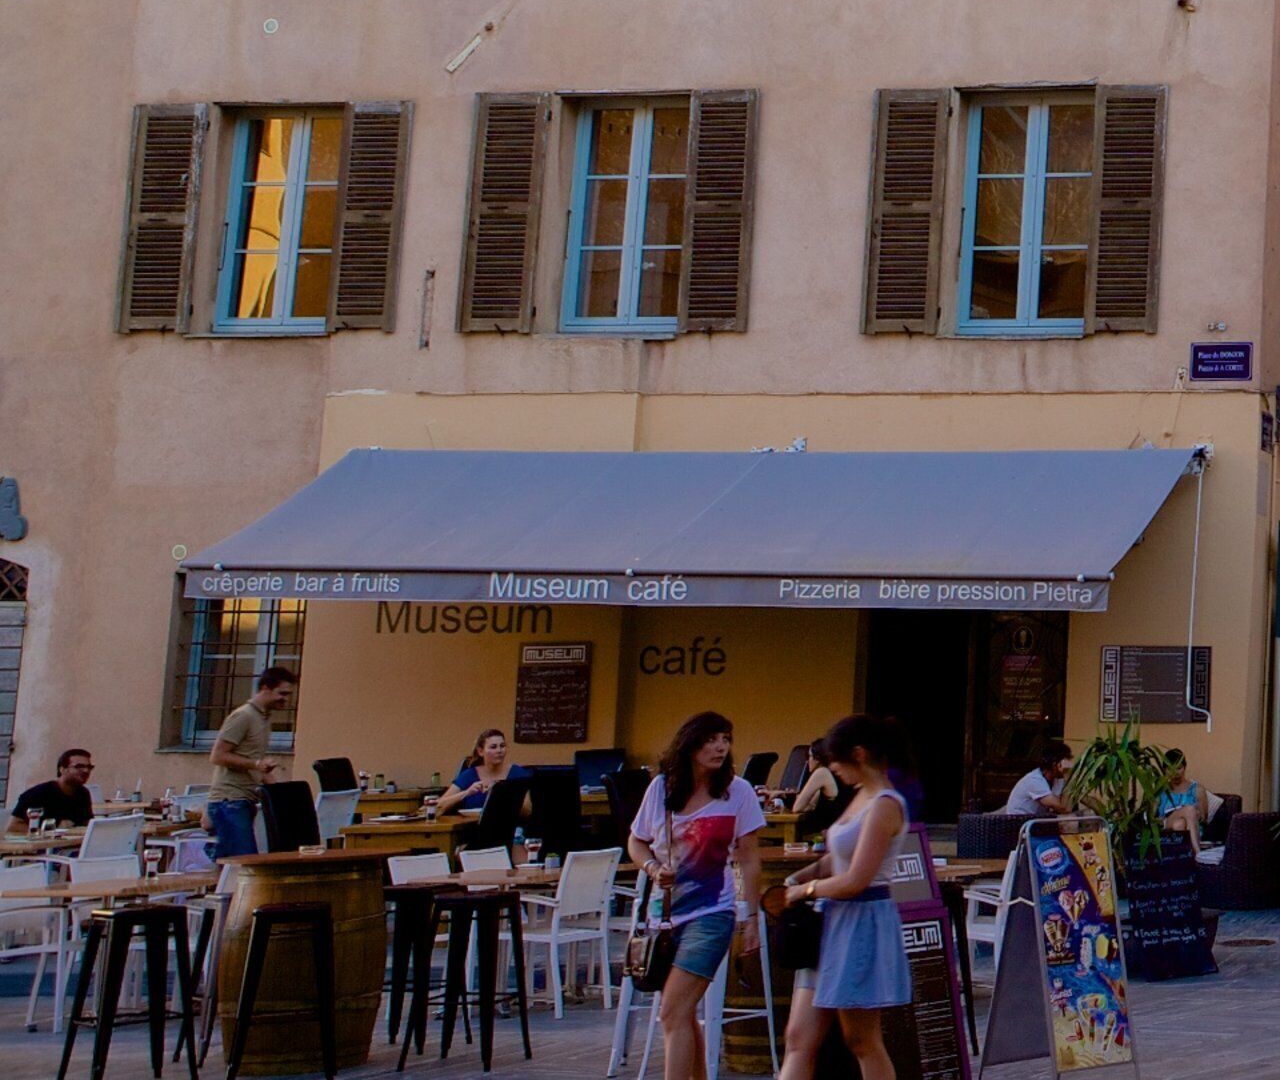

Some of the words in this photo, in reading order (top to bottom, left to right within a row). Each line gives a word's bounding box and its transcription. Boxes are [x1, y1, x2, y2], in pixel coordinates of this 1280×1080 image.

[202, 573, 283, 595] crêperie
[294, 574, 328, 592] bar
[332, 574, 345, 592] à
[351, 573, 400, 592] fruits
[488, 572, 609, 600] Museum
[627, 575, 688, 601] café
[779, 579, 861, 599] Pizzeria
[879, 579, 930, 599] bière
[937, 581, 1026, 602] pression
[1033, 582, 1093, 603] Pietra
[375, 600, 553, 634] Museum
[639, 636, 727, 676] café
